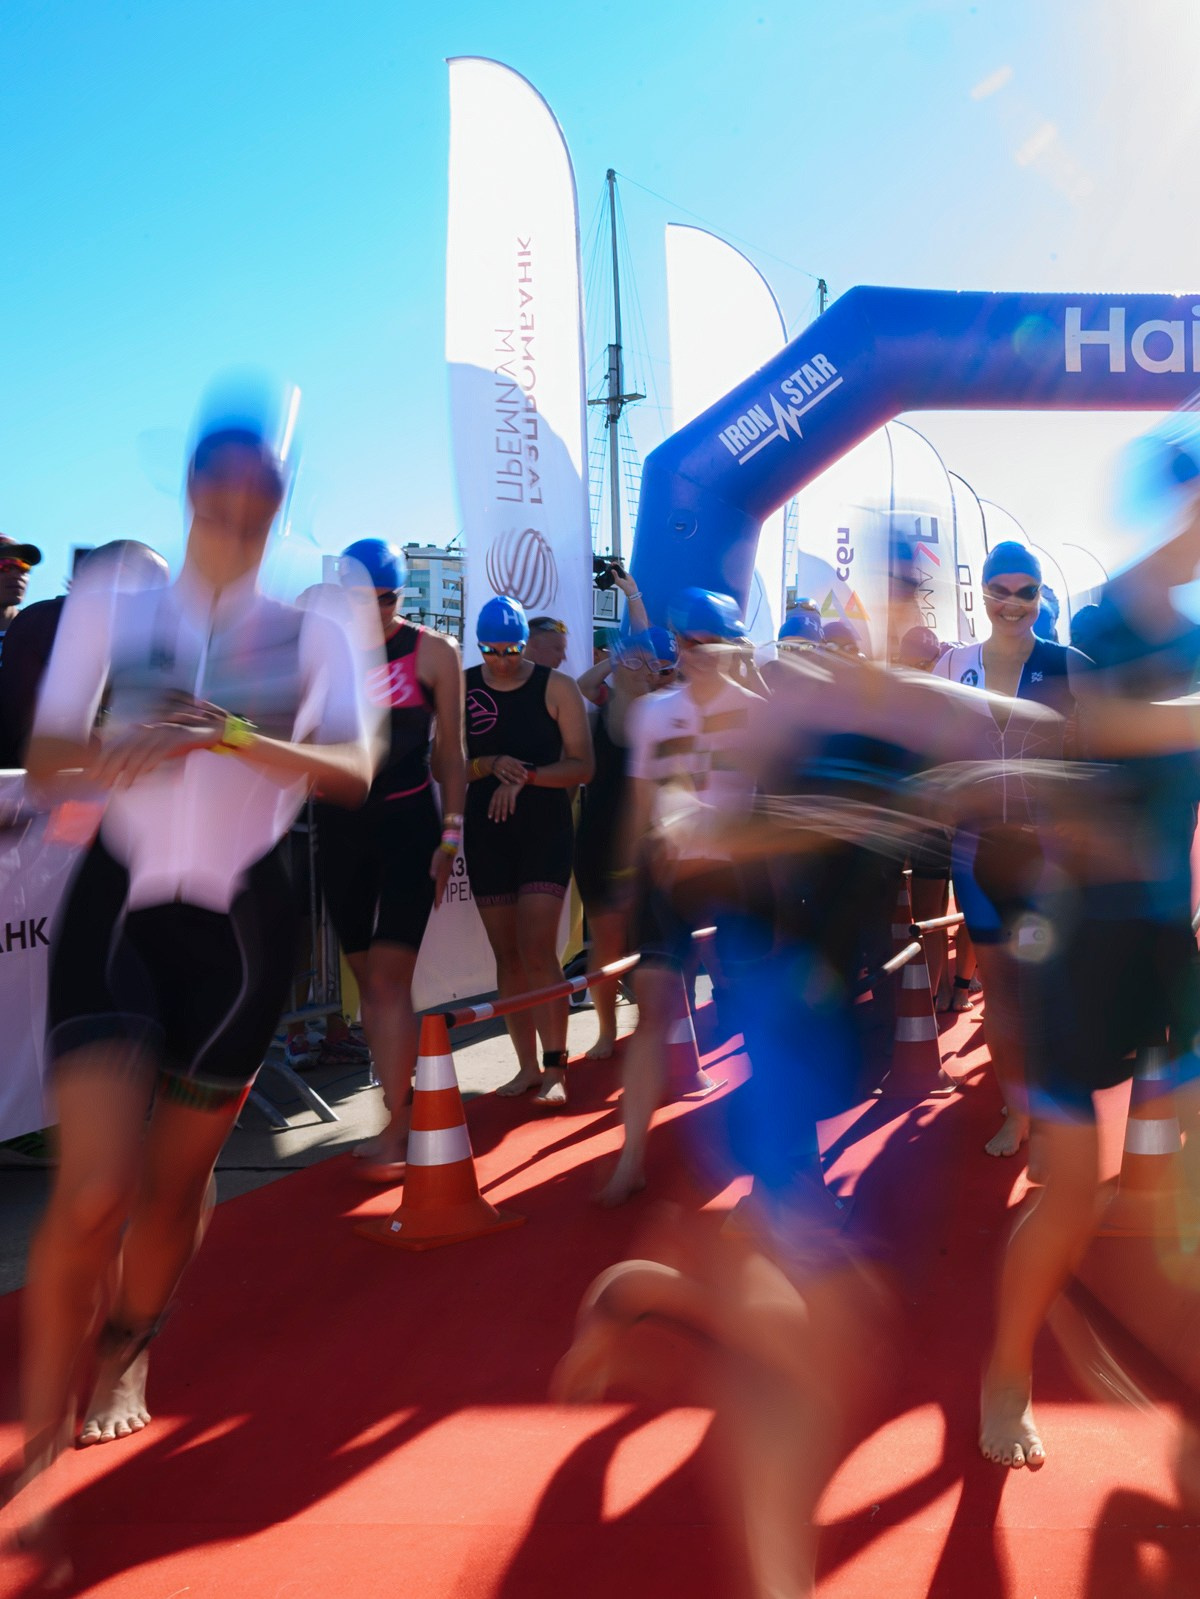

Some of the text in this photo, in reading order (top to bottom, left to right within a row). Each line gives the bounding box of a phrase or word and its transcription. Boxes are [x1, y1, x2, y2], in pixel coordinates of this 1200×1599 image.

[718, 353, 838, 456] IRON STAR
[0, 916, 51, 954] НК
